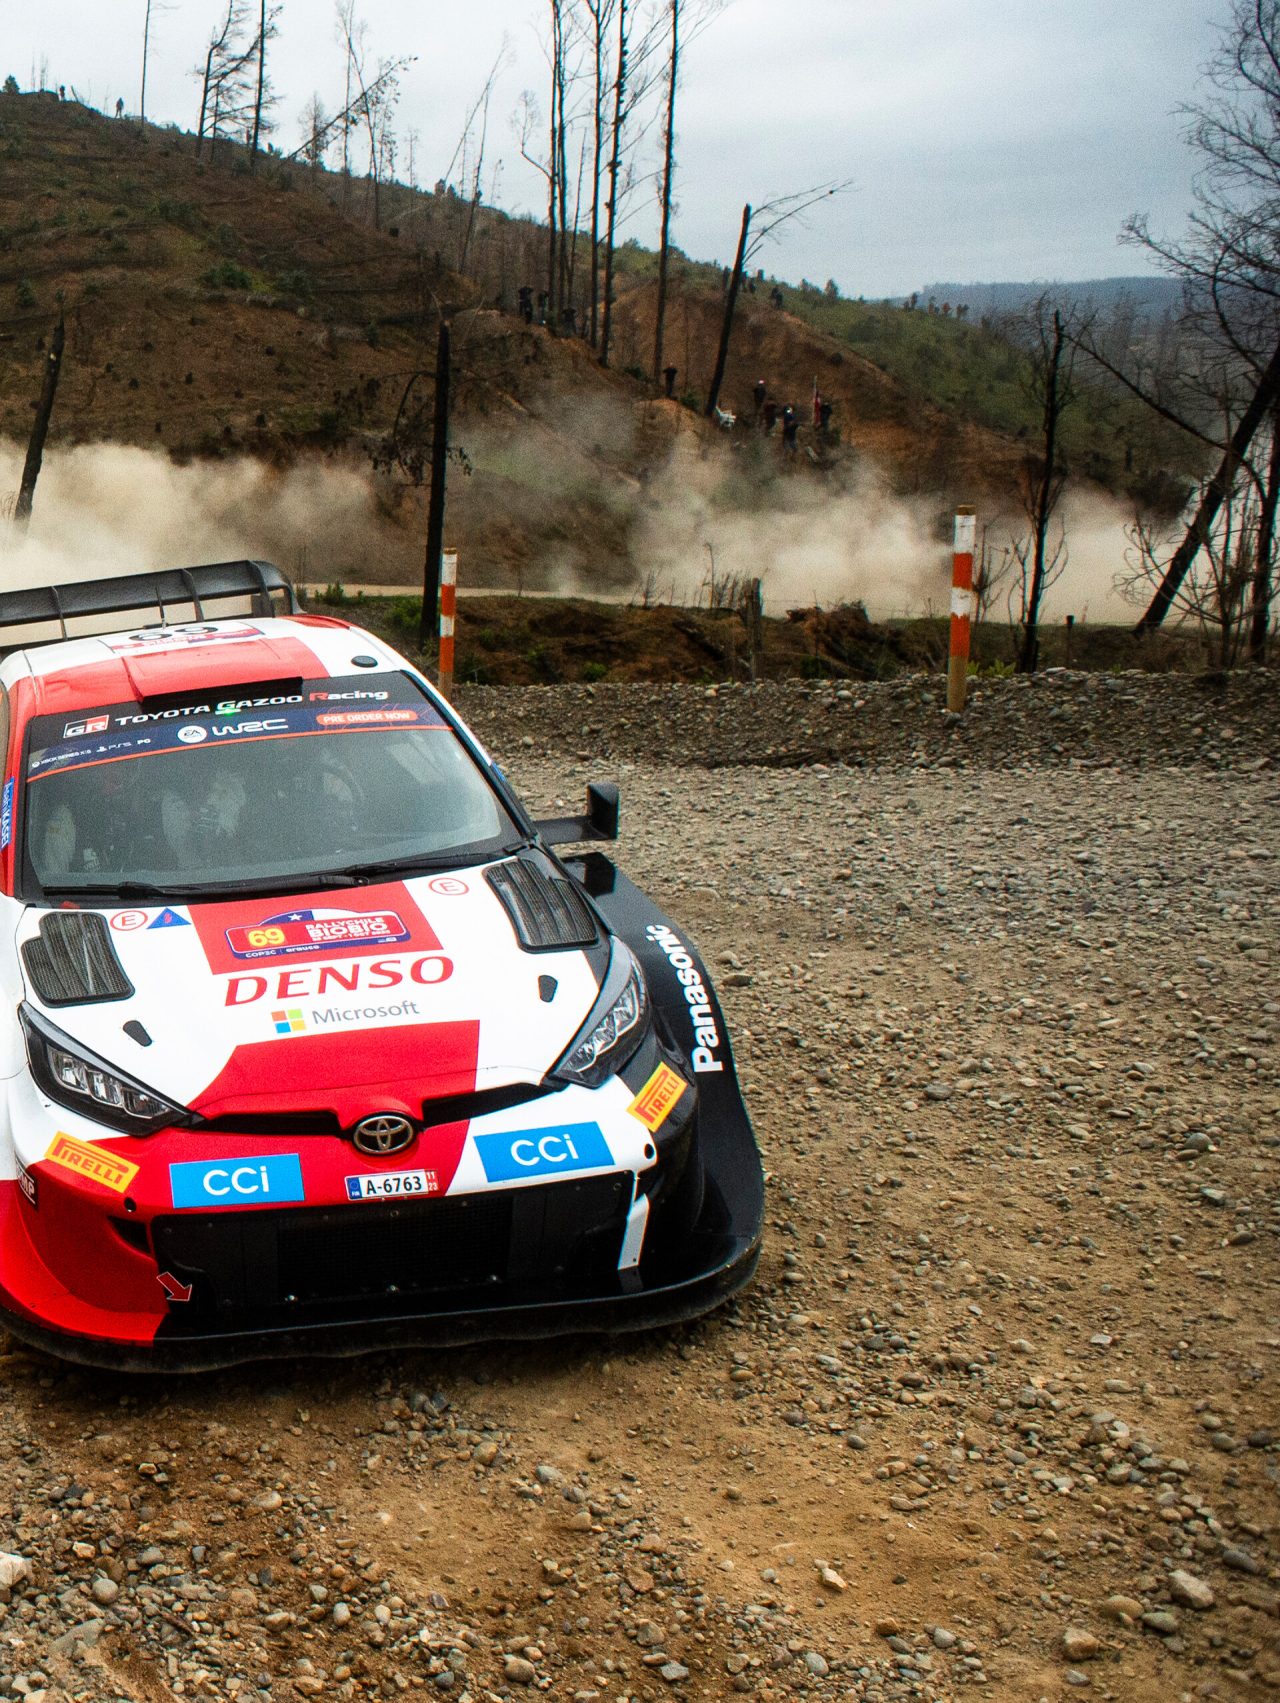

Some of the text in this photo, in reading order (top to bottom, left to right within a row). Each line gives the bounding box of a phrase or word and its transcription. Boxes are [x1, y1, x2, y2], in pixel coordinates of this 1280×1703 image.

[115, 690, 389, 726] TOYOTA GAZOO Racing
[323, 711, 410, 724] PRE ORDER NOW
[65, 721, 106, 735] GR
[212, 719, 289, 736] WRC
[248, 928, 286, 947] 69
[224, 955, 454, 1007] DENSO
[646, 924, 724, 1073] Panasonic
[311, 1000, 420, 1025] Microsoft
[634, 1069, 680, 1124] PIRELLI
[52, 1138, 130, 1185] PIRELLI
[366, 1175, 423, 1195] A-6763
[426, 1171, 436, 1180] 11
[428, 1182, 439, 1191] 23
